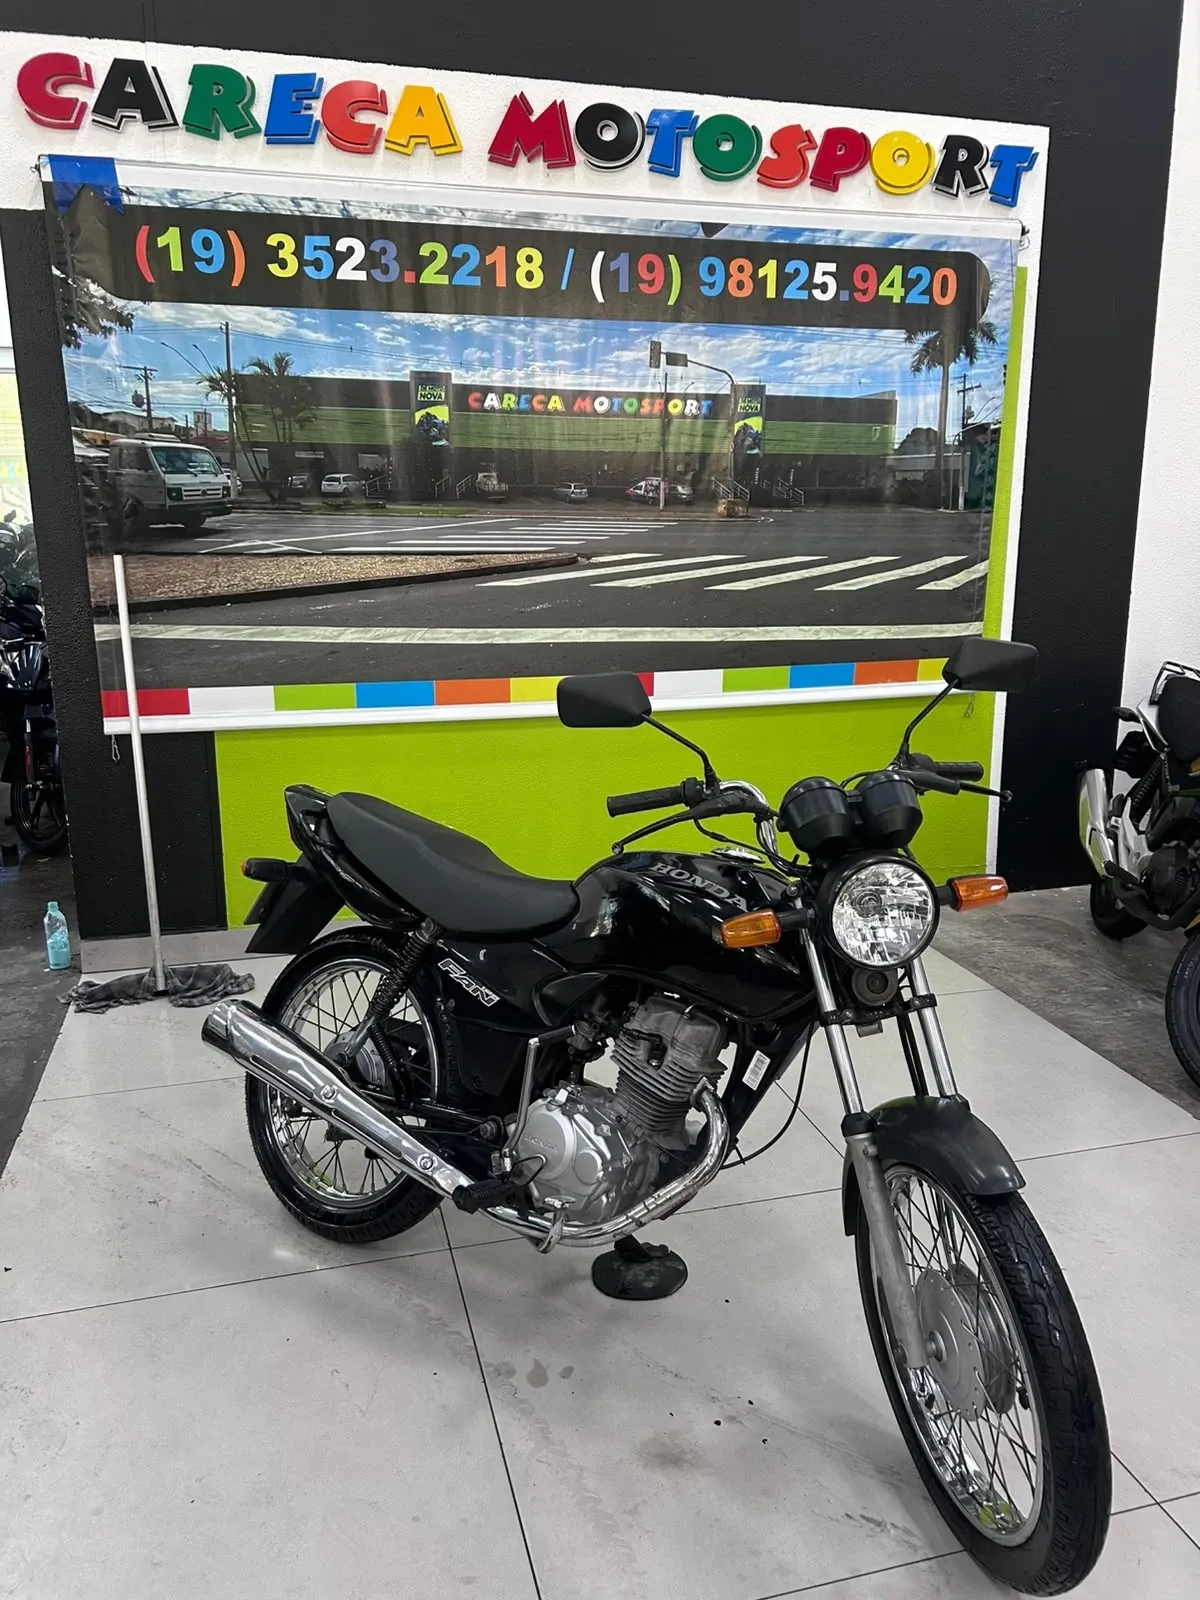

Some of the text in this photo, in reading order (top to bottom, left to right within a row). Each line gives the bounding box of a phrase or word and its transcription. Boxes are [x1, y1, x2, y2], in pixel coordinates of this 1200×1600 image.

[17, 52, 1039, 207] CARECA MOTOSPORT
[135, 224, 958, 306] (19) 3523.2218 / (19) 98125.9420
[419, 392, 443, 400] NOVA
[467, 391, 713, 417] CARECA MOTOSPORT
[649, 862, 749, 913] HONDA
[437, 957, 500, 1007] FAN
